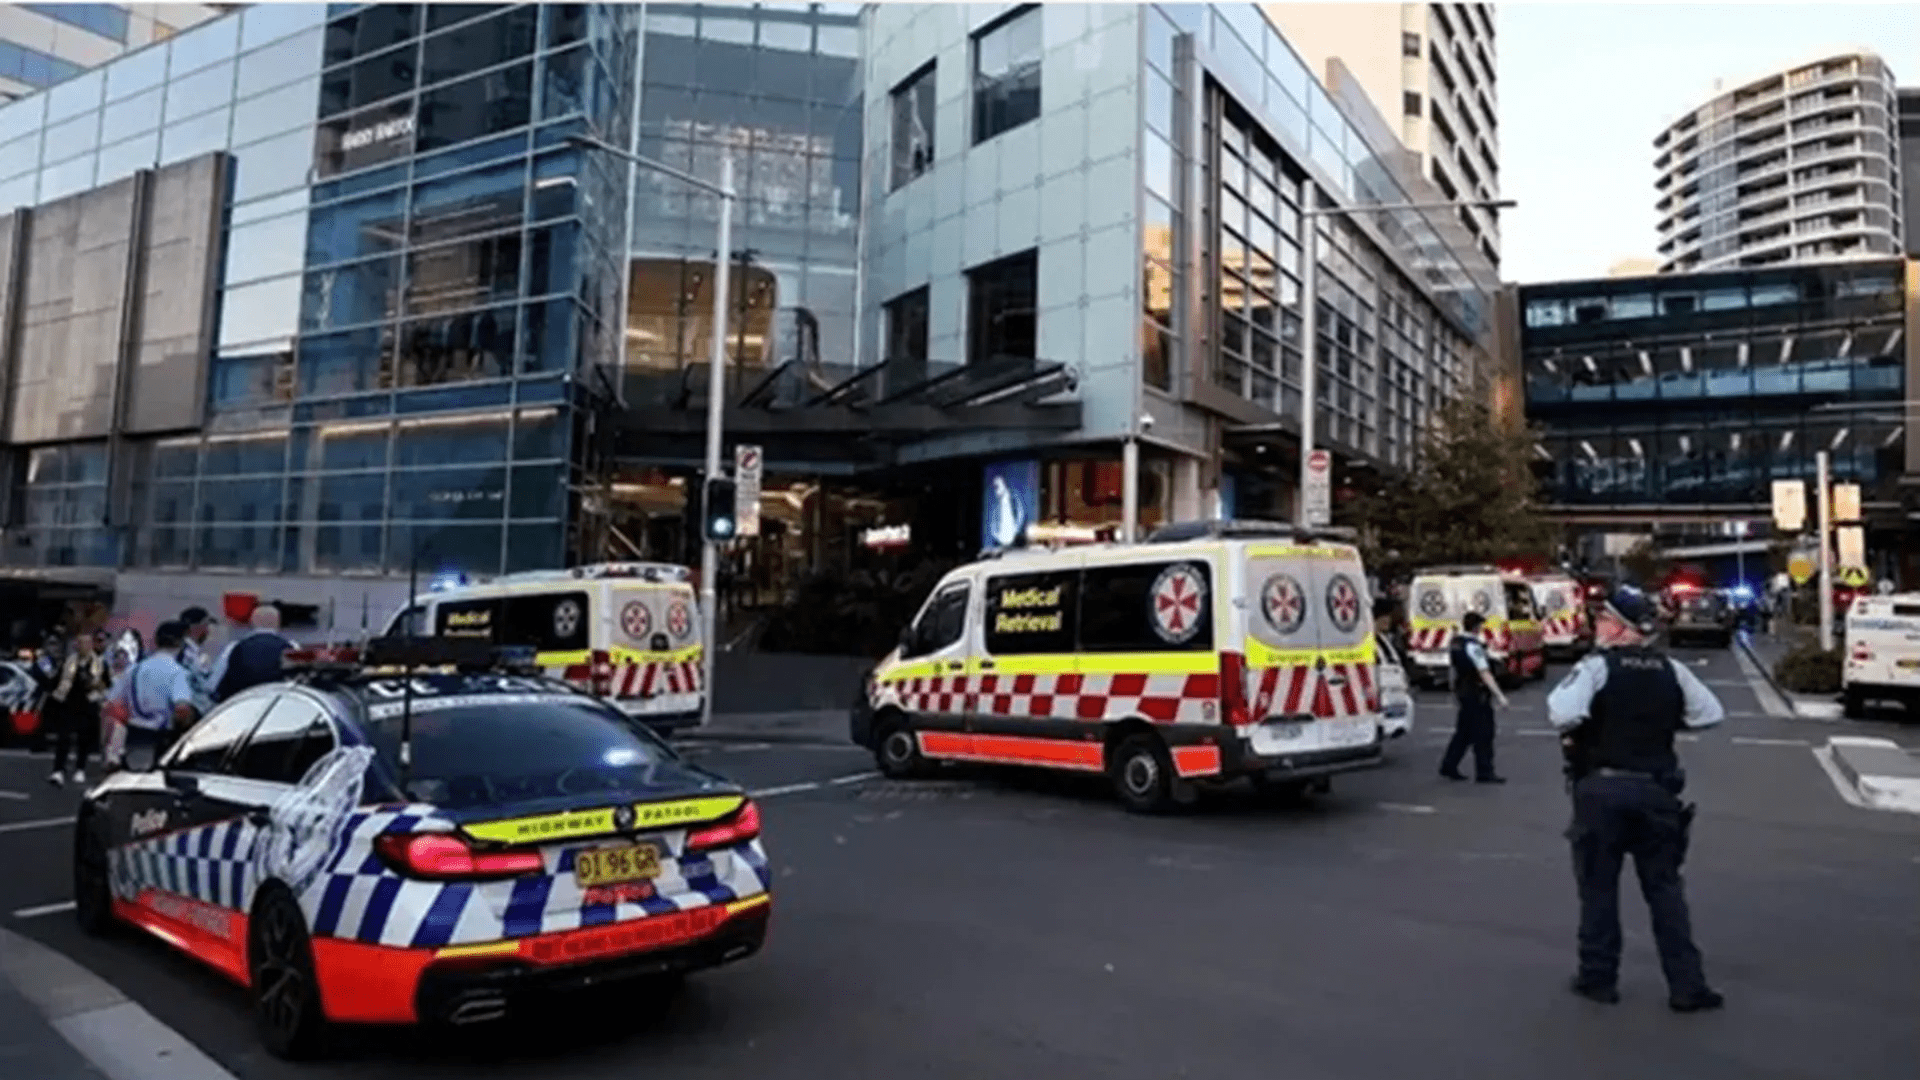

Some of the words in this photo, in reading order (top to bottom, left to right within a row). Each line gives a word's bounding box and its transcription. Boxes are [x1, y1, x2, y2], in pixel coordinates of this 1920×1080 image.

[1001, 587, 1061, 608] Medical
[995, 611, 1063, 633] Retrieval
[1621, 657, 1664, 670] POLICE
[131, 808, 168, 836] Police
[516, 813, 605, 834] HIGHWAY
[643, 804, 701, 821] PATROL
